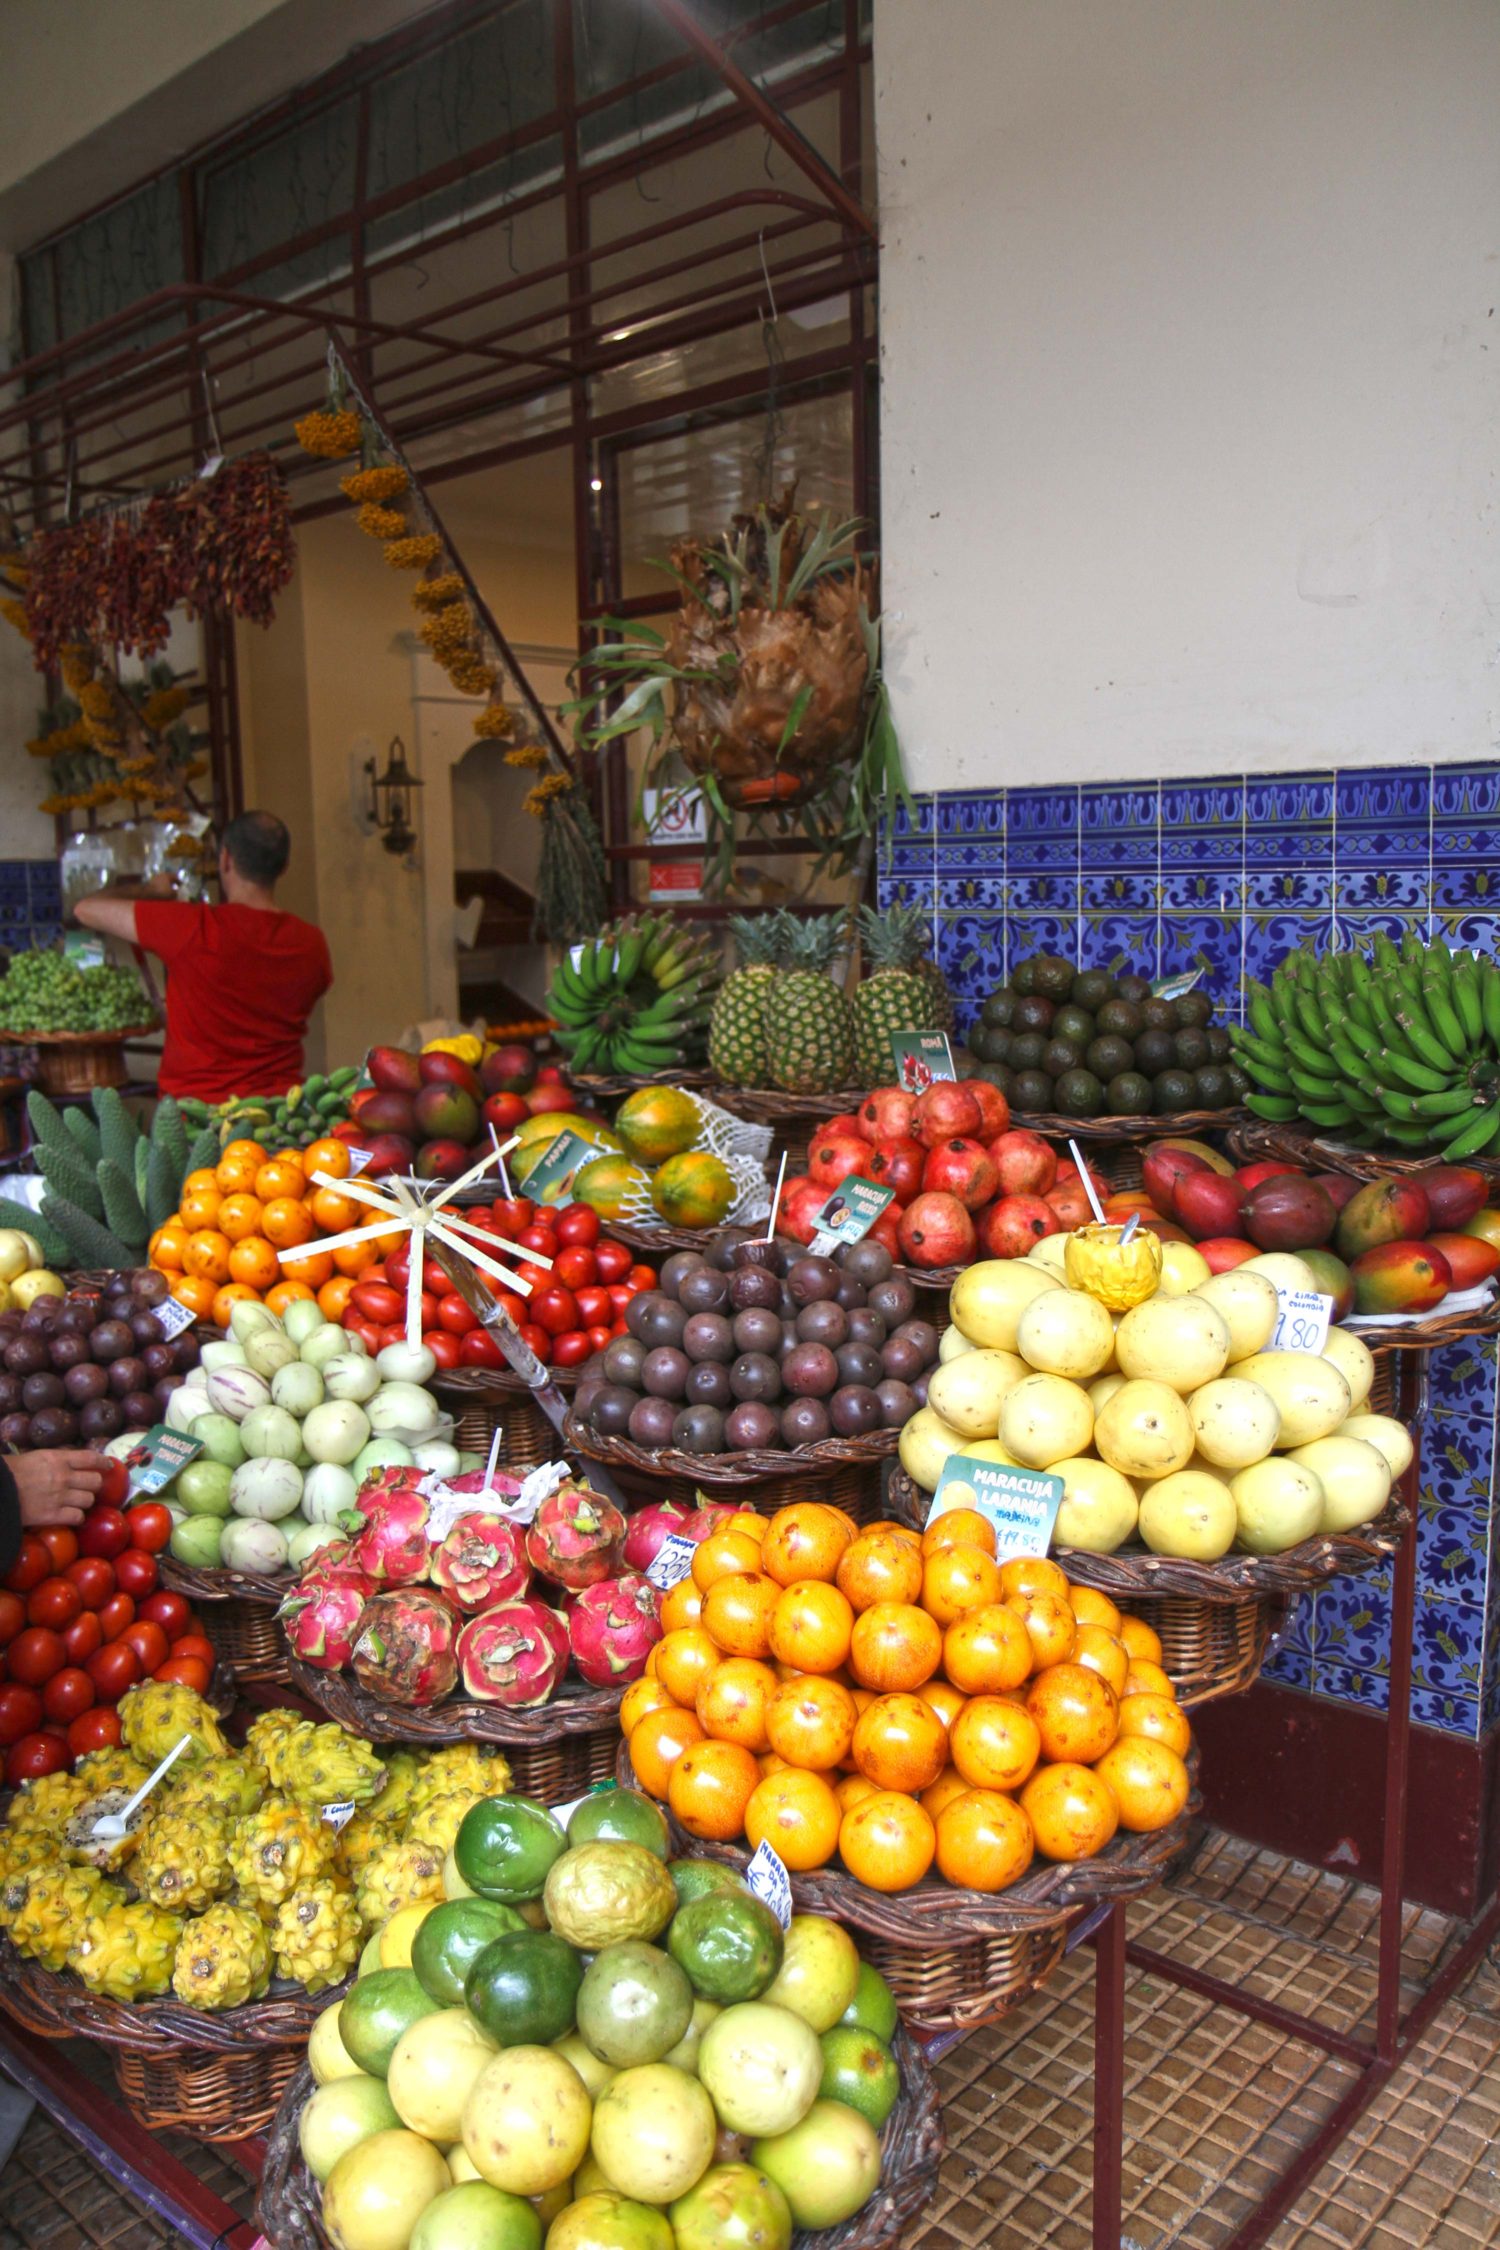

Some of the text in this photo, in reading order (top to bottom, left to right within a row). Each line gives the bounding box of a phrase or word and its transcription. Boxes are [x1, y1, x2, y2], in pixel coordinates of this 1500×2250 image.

[851, 1184, 888, 1205] MARACUJÁ
[973, 1468, 1053, 1498] MARACUJÁ
[981, 1489, 1048, 1517] LARANJA
